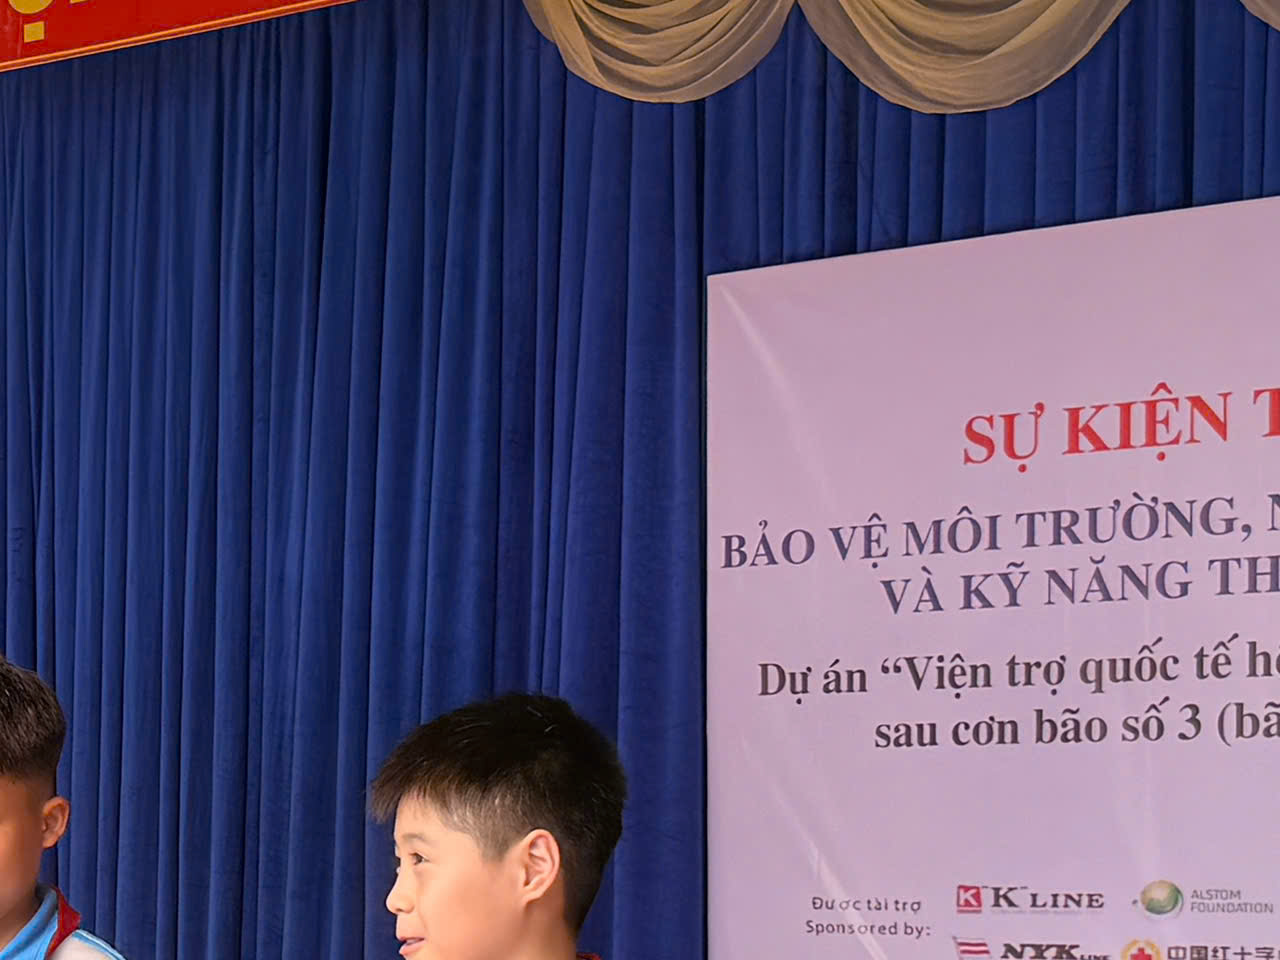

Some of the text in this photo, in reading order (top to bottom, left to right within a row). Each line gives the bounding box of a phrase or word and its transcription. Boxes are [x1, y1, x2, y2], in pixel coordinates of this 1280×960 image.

[963, 401, 1045, 473] SỰ
[1061, 381, 1233, 462] KIỆN
[719, 520, 815, 570] BẢO
[828, 512, 890, 570] VỆ
[902, 505, 1002, 557] MÔI
[1015, 491, 1252, 549] TRƯỜNG,
[879, 565, 944, 615] VÀ
[959, 560, 1030, 612] KỸ
[1043, 555, 1193, 606] NĂNG
[758, 661, 813, 705] Dự
[822, 658, 869, 695] án
[1005, 651, 1067, 697] trợ
[1079, 635, 1180, 695] quốc
[1193, 632, 1239, 680] tế
[874, 718, 939, 749] sau
[951, 715, 1020, 746] cơn
[1034, 706, 1108, 745] bão
[1121, 695, 1172, 744] số
[1177, 702, 1203, 741] 3
[1029, 892, 1105, 908] LINE
[1190, 889, 1242, 900] ALSTOM
[1190, 902, 1274, 913] FOUNDATION
[805, 919, 931, 940] Sponsored by:
[1000, 943, 1080, 960] NYK
